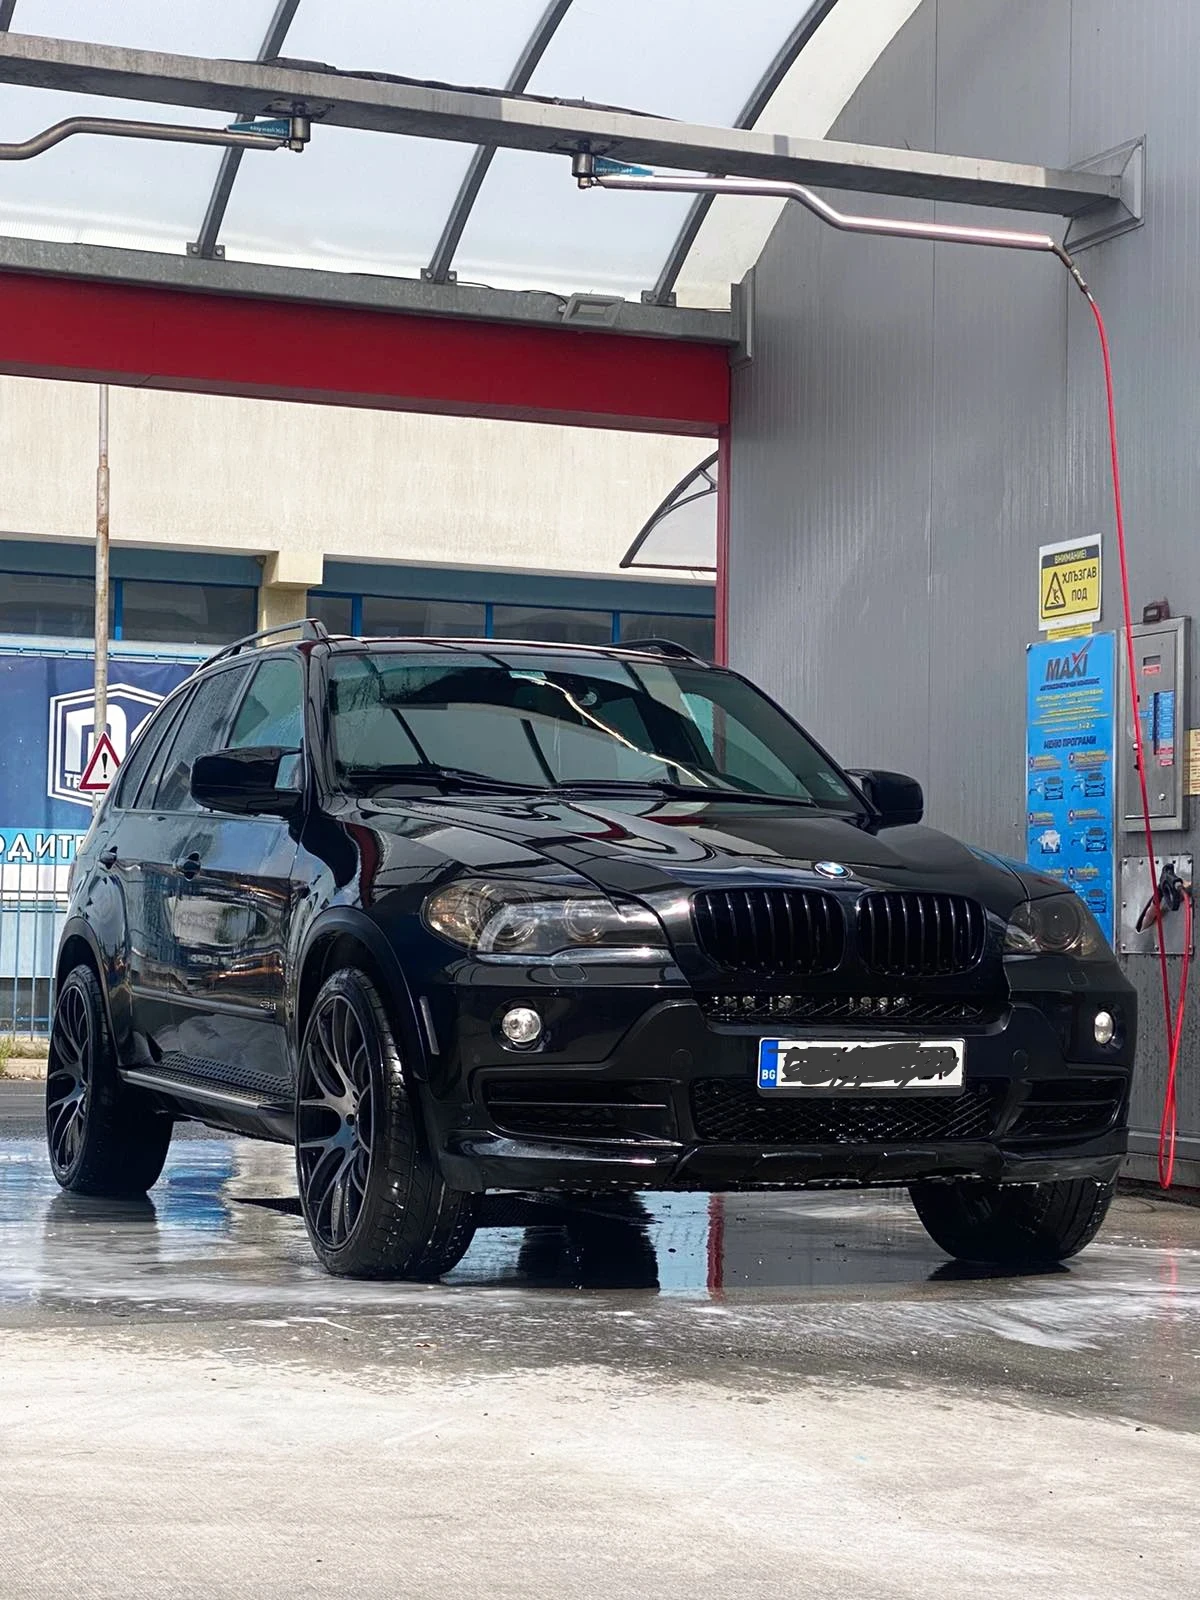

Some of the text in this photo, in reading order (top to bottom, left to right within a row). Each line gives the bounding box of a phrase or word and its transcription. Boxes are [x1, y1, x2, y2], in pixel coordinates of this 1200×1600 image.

[1062, 566, 1097, 584] ХЛЪЗГАВ
[1071, 587, 1088, 601] ПОД
[1046, 643, 1092, 681] MAXI
[762, 1070, 775, 1080] BG
